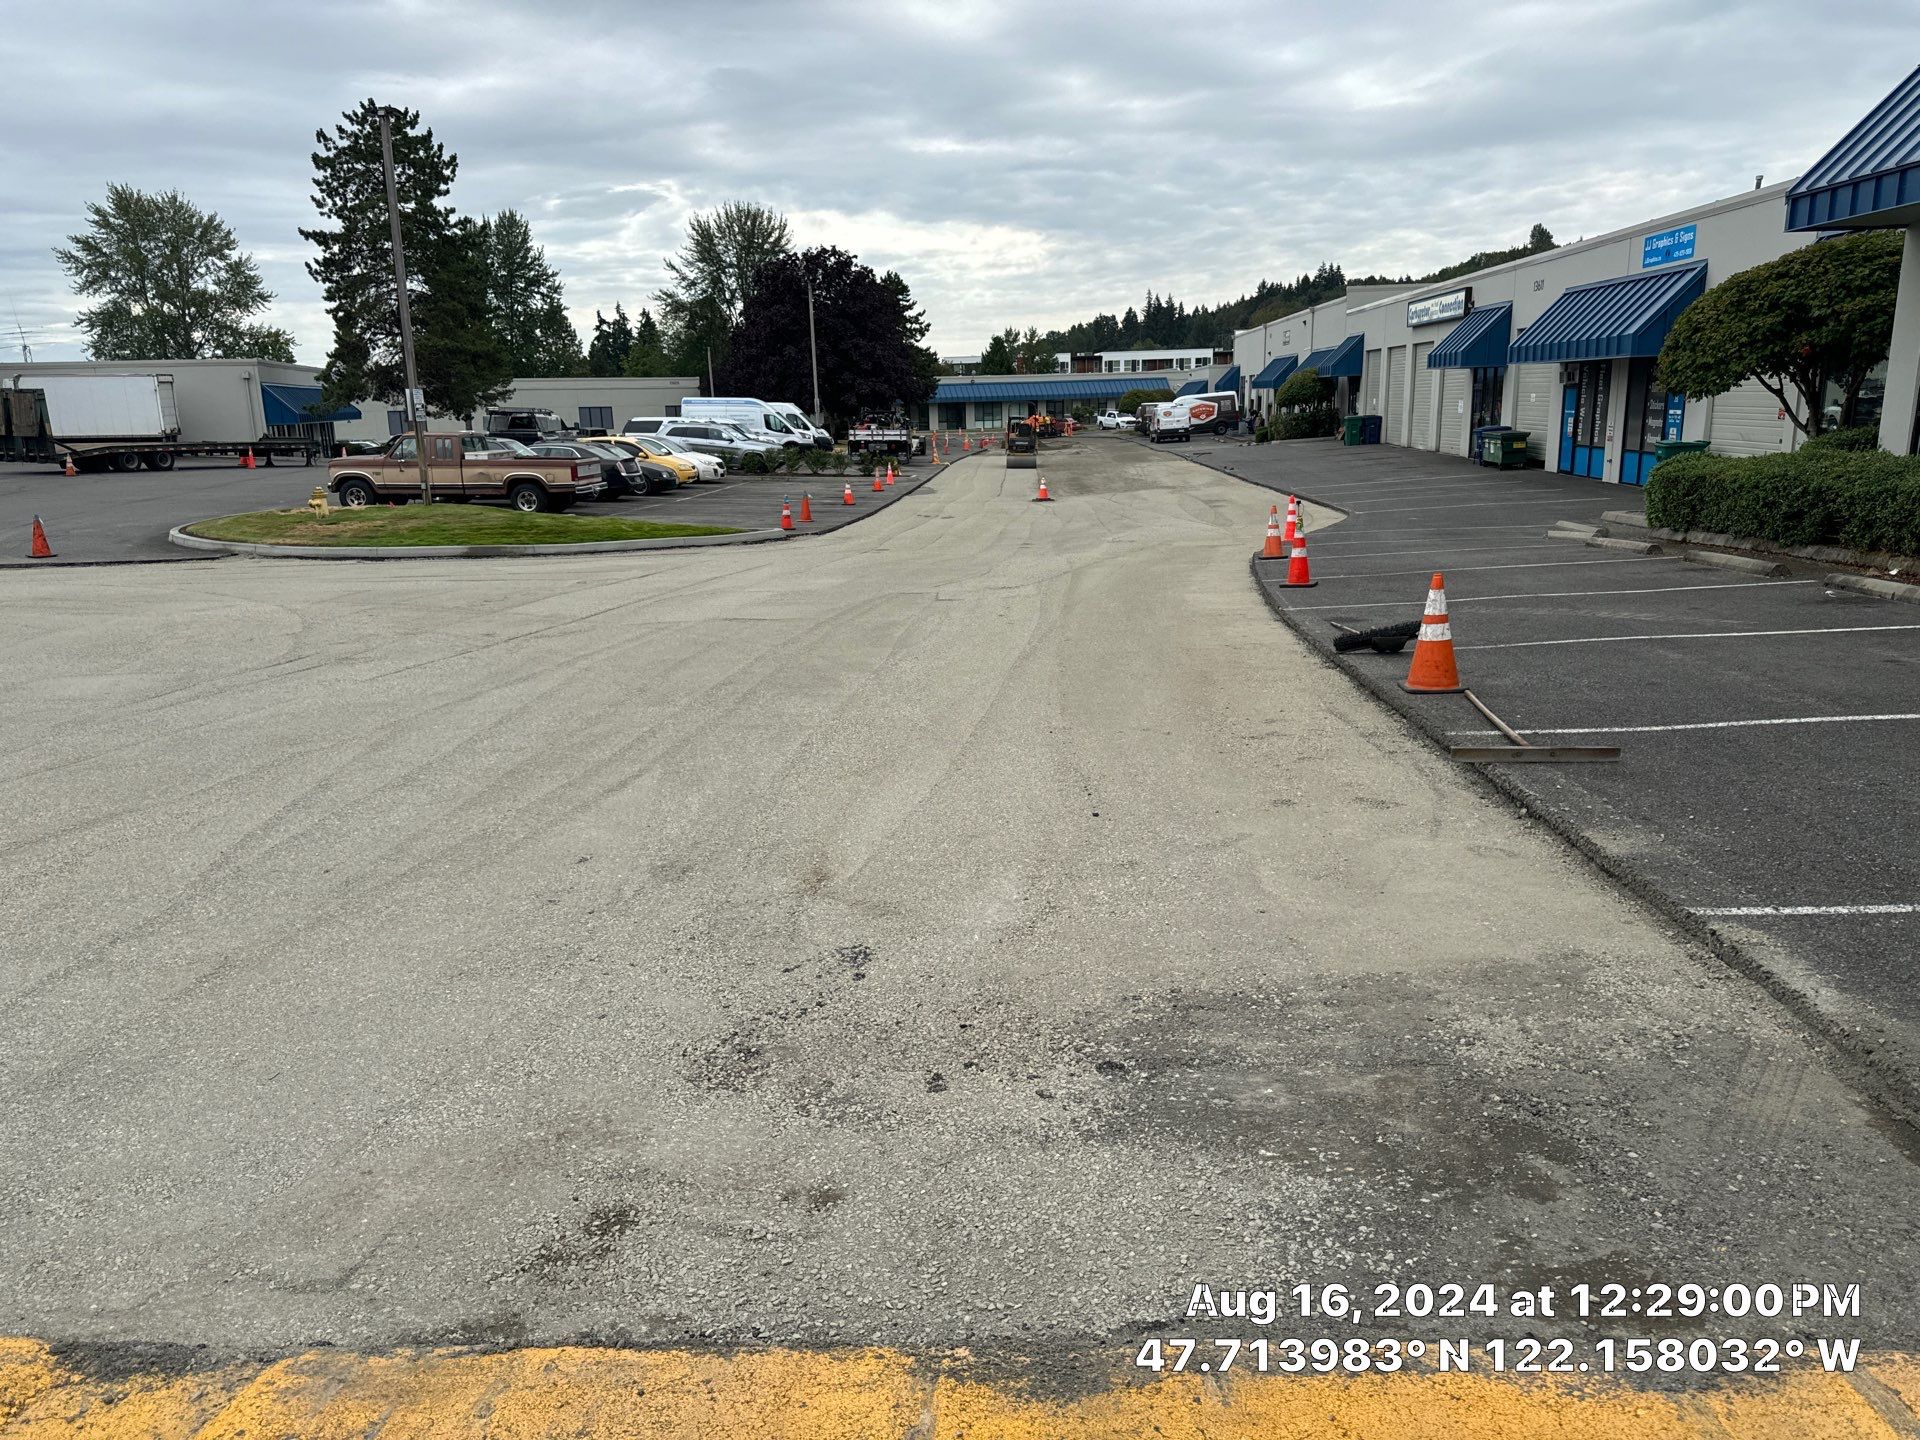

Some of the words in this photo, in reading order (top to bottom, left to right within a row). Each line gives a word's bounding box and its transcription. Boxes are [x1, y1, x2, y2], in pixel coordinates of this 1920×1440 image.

[1652, 236, 1674, 250] Graphics
[1674, 232, 1680, 244] &
[1680, 231, 1694, 244] Signs
[1409, 305, 1431, 322] Carburetor
[1439, 295, 1464, 314] Connection
[1580, 366, 1589, 404] Vehicle
[1577, 407, 1586, 442] Wraps
[1594, 394, 1604, 443] Graphics
